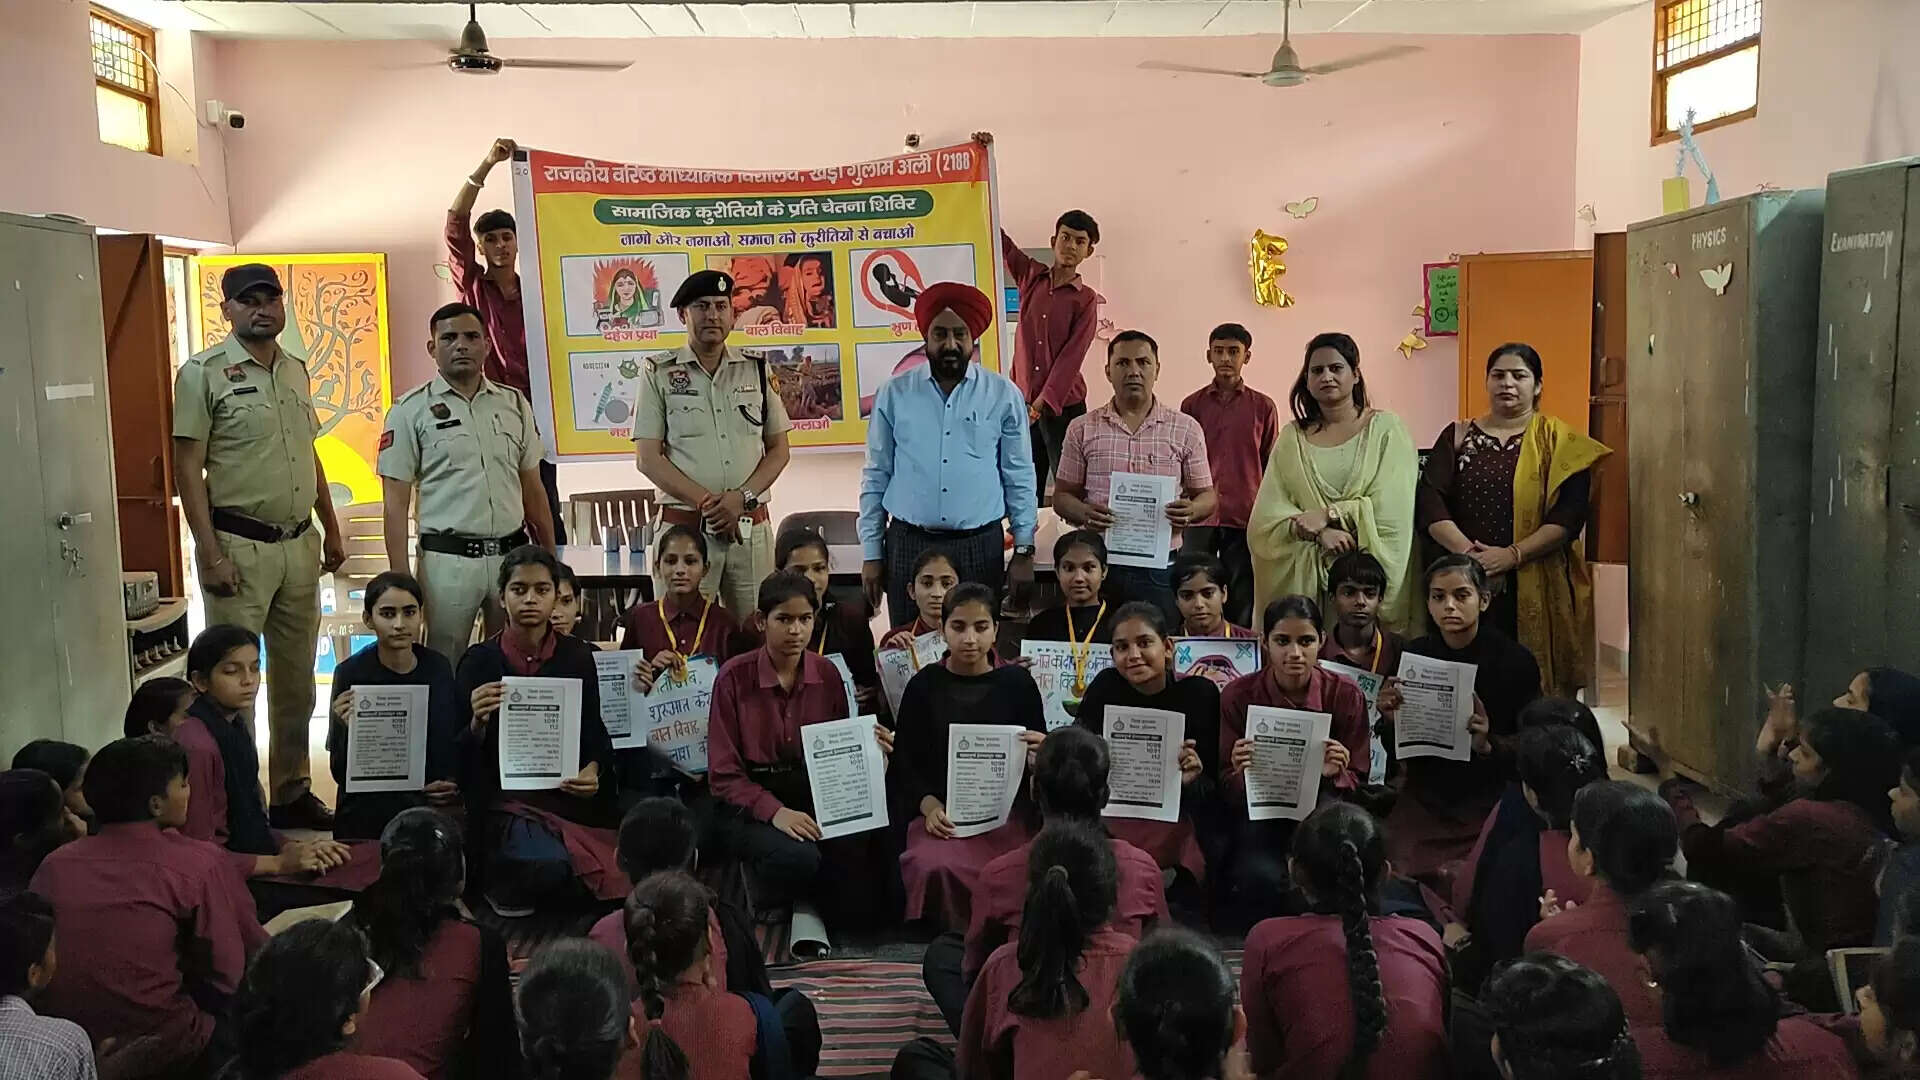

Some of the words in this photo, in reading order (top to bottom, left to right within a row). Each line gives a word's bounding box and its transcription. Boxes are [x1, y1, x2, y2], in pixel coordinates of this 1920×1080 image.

[543, 160, 609, 184] राजकीय
[612, 162, 657, 184] वरिष्ठ
[847, 159, 894, 186] गुलाम
[897, 153, 932, 175] अली
[611, 203, 692, 220] सामाजिक
[695, 201, 764, 225] कुरीतियों
[767, 200, 786, 217] के
[788, 198, 819, 218] प्रति
[822, 198, 867, 215] चेतना
[869, 194, 918, 213] शिविर
[620, 230, 651, 246] जागो
[656, 232, 681, 245] और
[738, 233, 775, 246] समाज
[778, 229, 796, 245] को
[858, 226, 869, 241] से
[873, 223, 915, 241] बचाओ
[1691, 226, 1727, 250] PHYSICS
[604, 328, 633, 342] दहेज
[745, 325, 769, 336] बाल
[771, 323, 804, 336] विवाह
